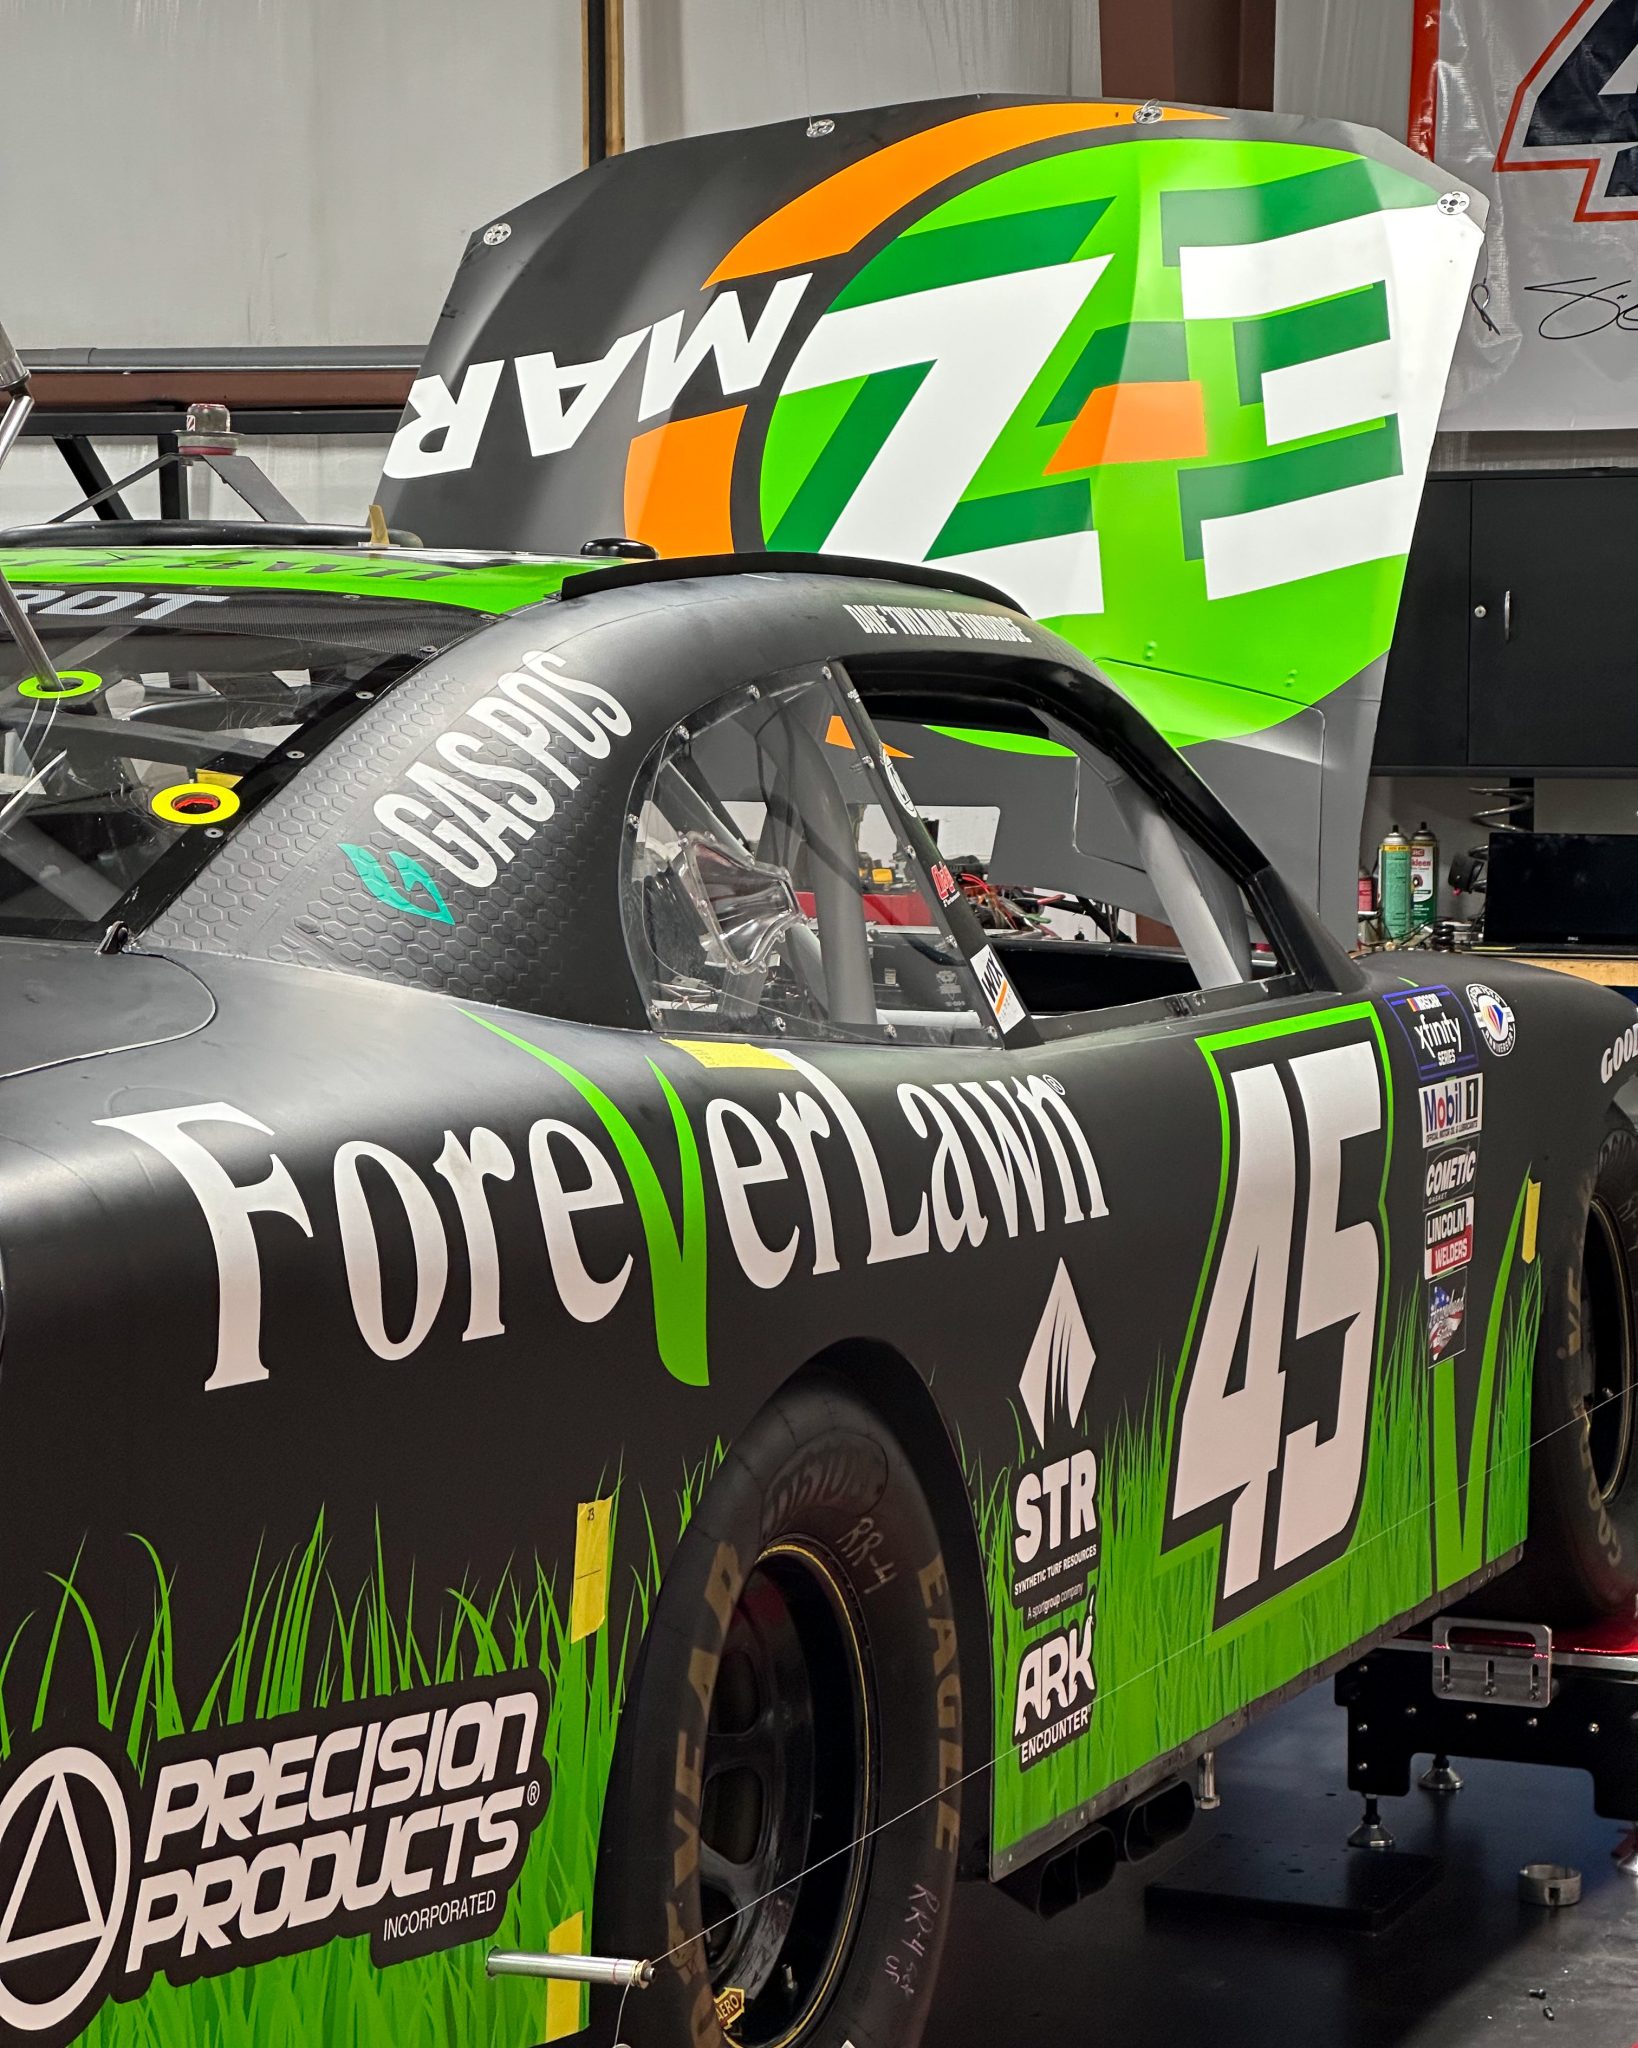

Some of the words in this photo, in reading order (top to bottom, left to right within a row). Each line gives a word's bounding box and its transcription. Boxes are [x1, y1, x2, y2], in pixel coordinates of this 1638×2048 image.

[842, 604, 897, 634] DAVE
[981, 951, 1003, 1003] WIX
[1414, 1012, 1462, 1059] xfinity
[1437, 1049, 1457, 1067] SERIES
[1423, 1082, 1463, 1133] Mobil
[1425, 1150, 1476, 1197] COMETIC
[1427, 1206, 1465, 1244] LINCOLN
[1434, 1238, 1468, 1269] WELDERS
[1172, 1041, 1382, 1600] 45
[1015, 1449, 1097, 1563] STR
[1014, 1569, 1047, 1596] SYNTHETIC
[1047, 1561, 1063, 1579] TURF
[1063, 1544, 1097, 1570] RESOURCES
[1060, 1582, 1084, 1602] company
[1015, 1597, 1095, 1736] ARK
[917, 1553, 963, 1853] EAGLE
[1021, 1712, 1088, 1764] ENCOUNTER
[144, 1692, 539, 1863] PRECISION
[383, 1889, 496, 1942] INCORPORATED
[715, 1994, 739, 2021] AERO
